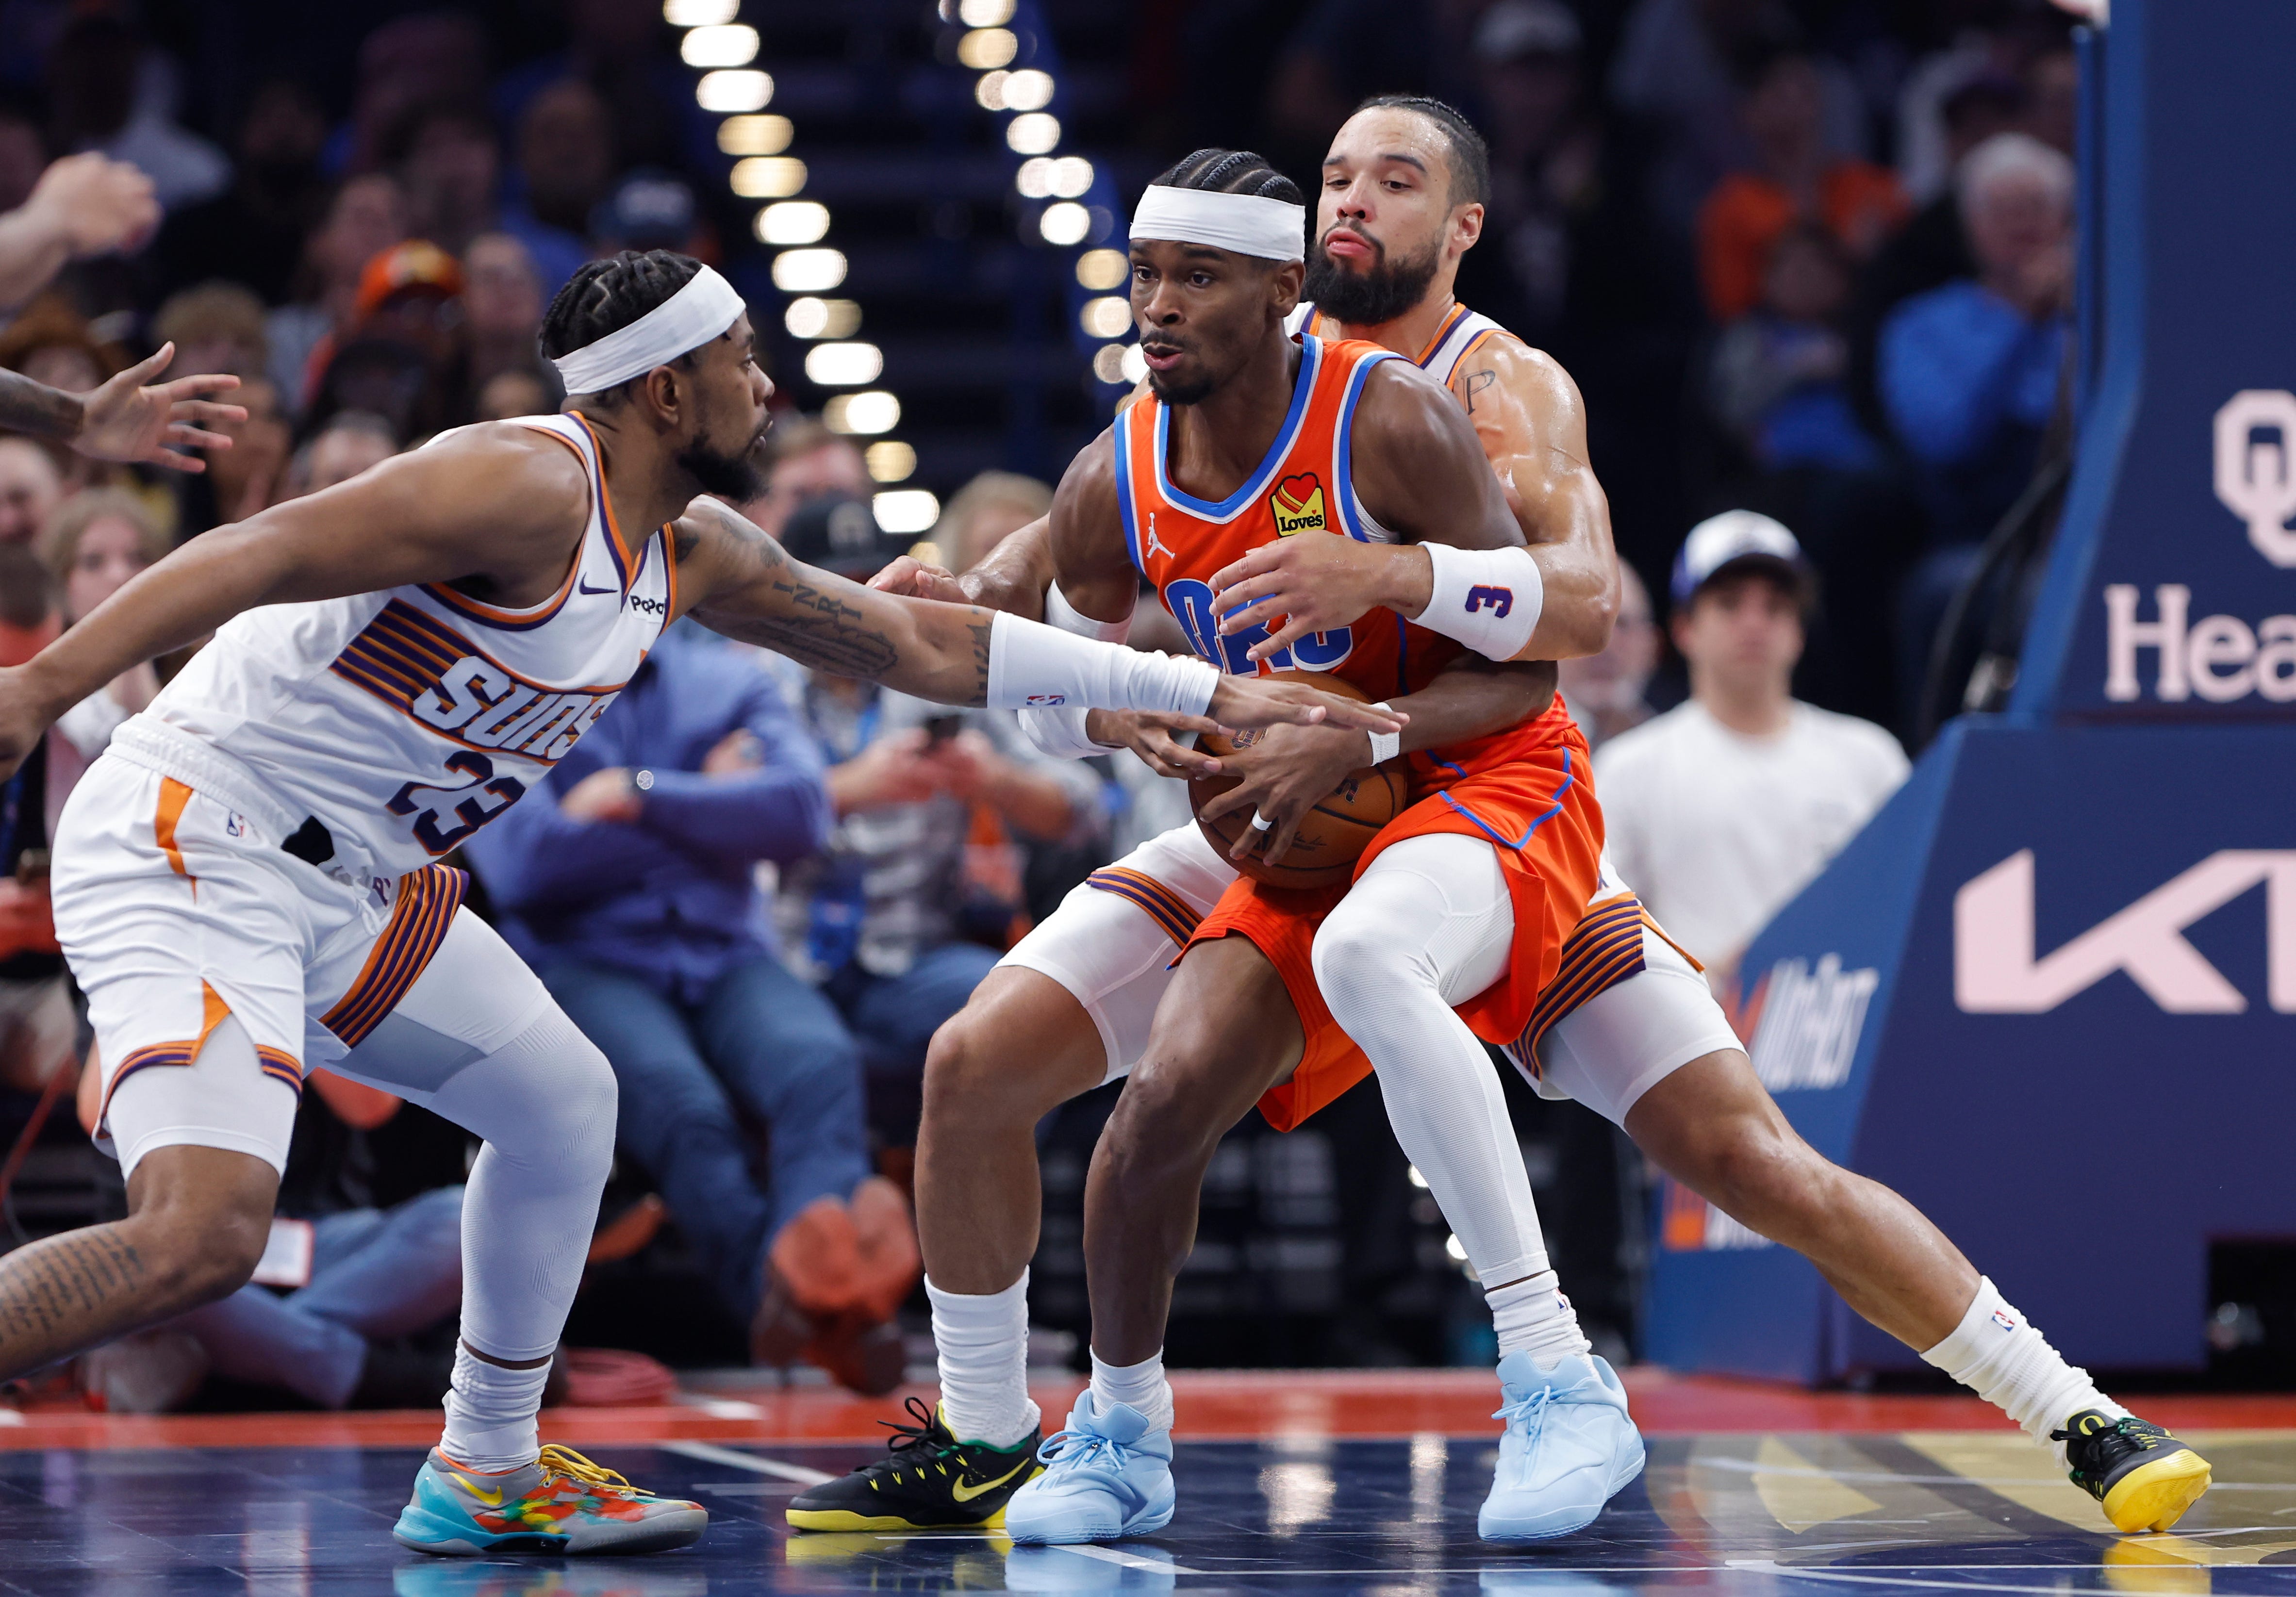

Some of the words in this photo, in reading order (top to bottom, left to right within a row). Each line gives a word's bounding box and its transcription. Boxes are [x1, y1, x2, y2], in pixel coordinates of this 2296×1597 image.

[773, 580, 862, 621] INRI
[1465, 584, 1513, 618] 3
[385, 750, 526, 856] 23
